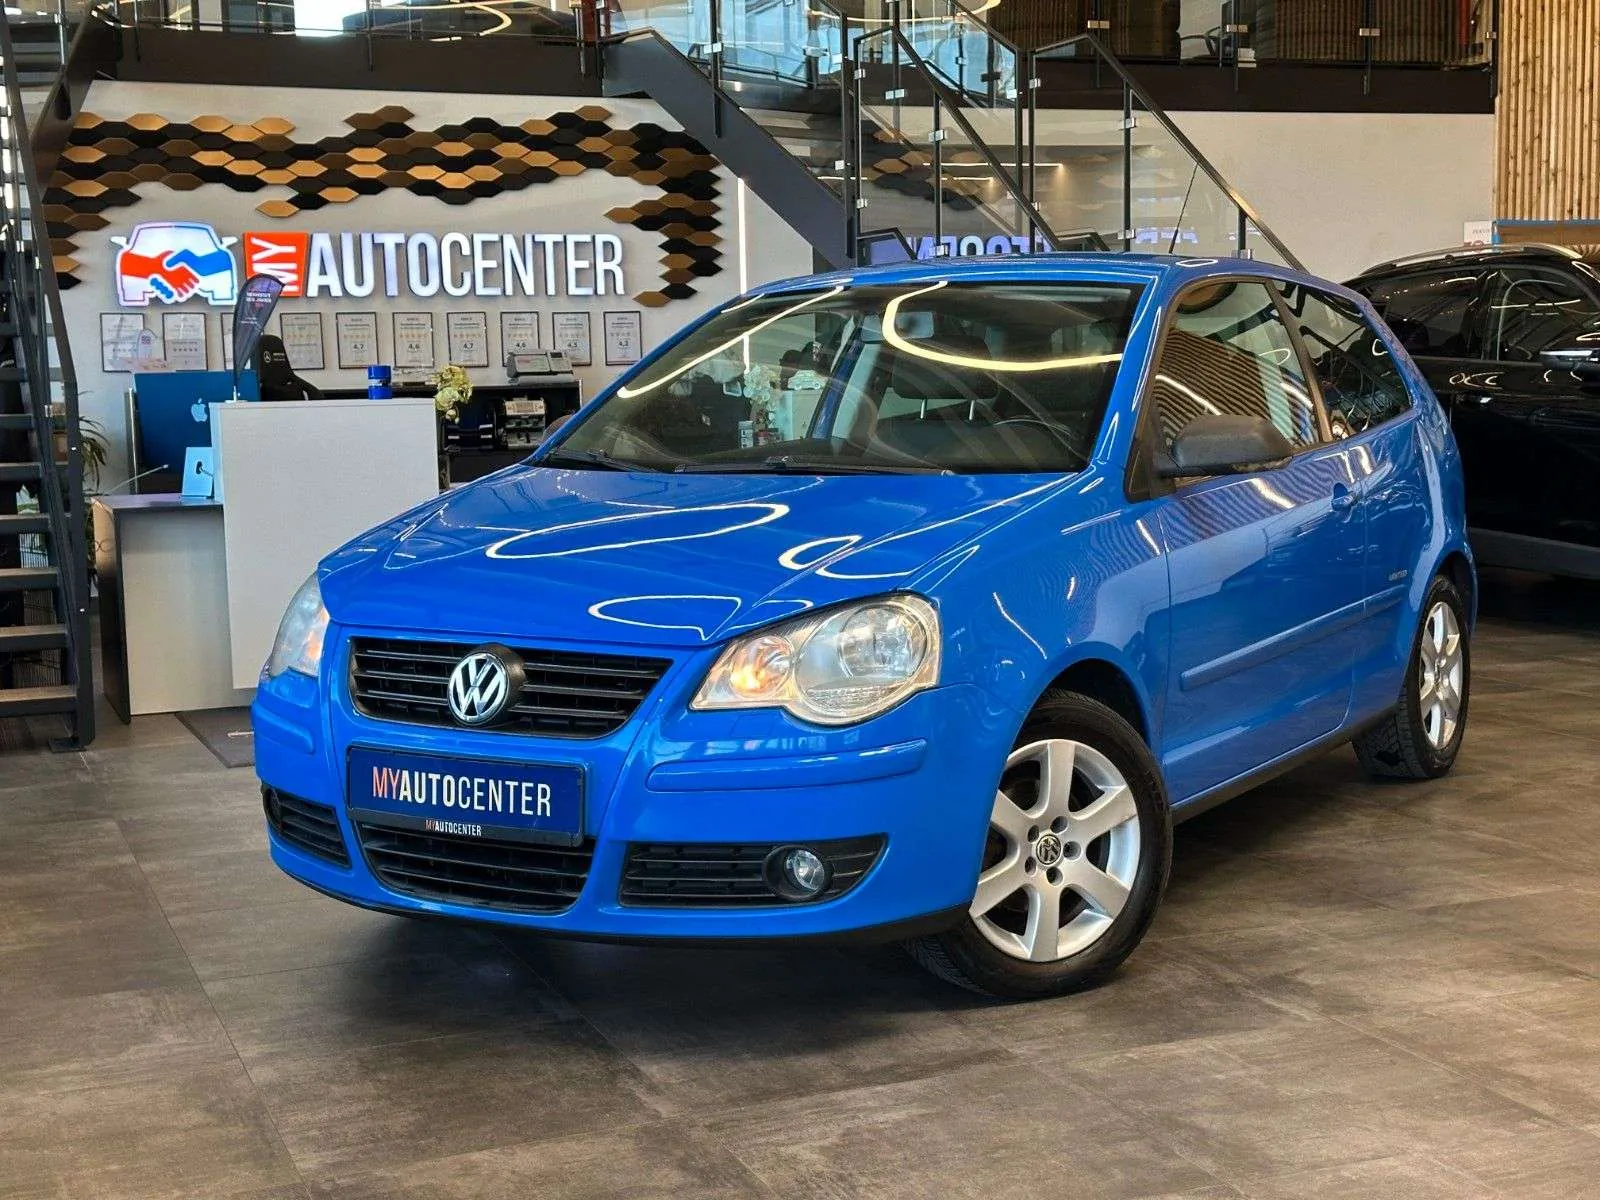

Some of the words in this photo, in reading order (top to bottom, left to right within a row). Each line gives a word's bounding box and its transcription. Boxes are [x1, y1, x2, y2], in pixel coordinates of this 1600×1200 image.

[306, 232, 626, 298] AUTOCENTER
[449, 653, 507, 722] VW
[372, 766, 551, 817] MYAUTOCENTER
[424, 819, 482, 837] MYAUTOCENTER
